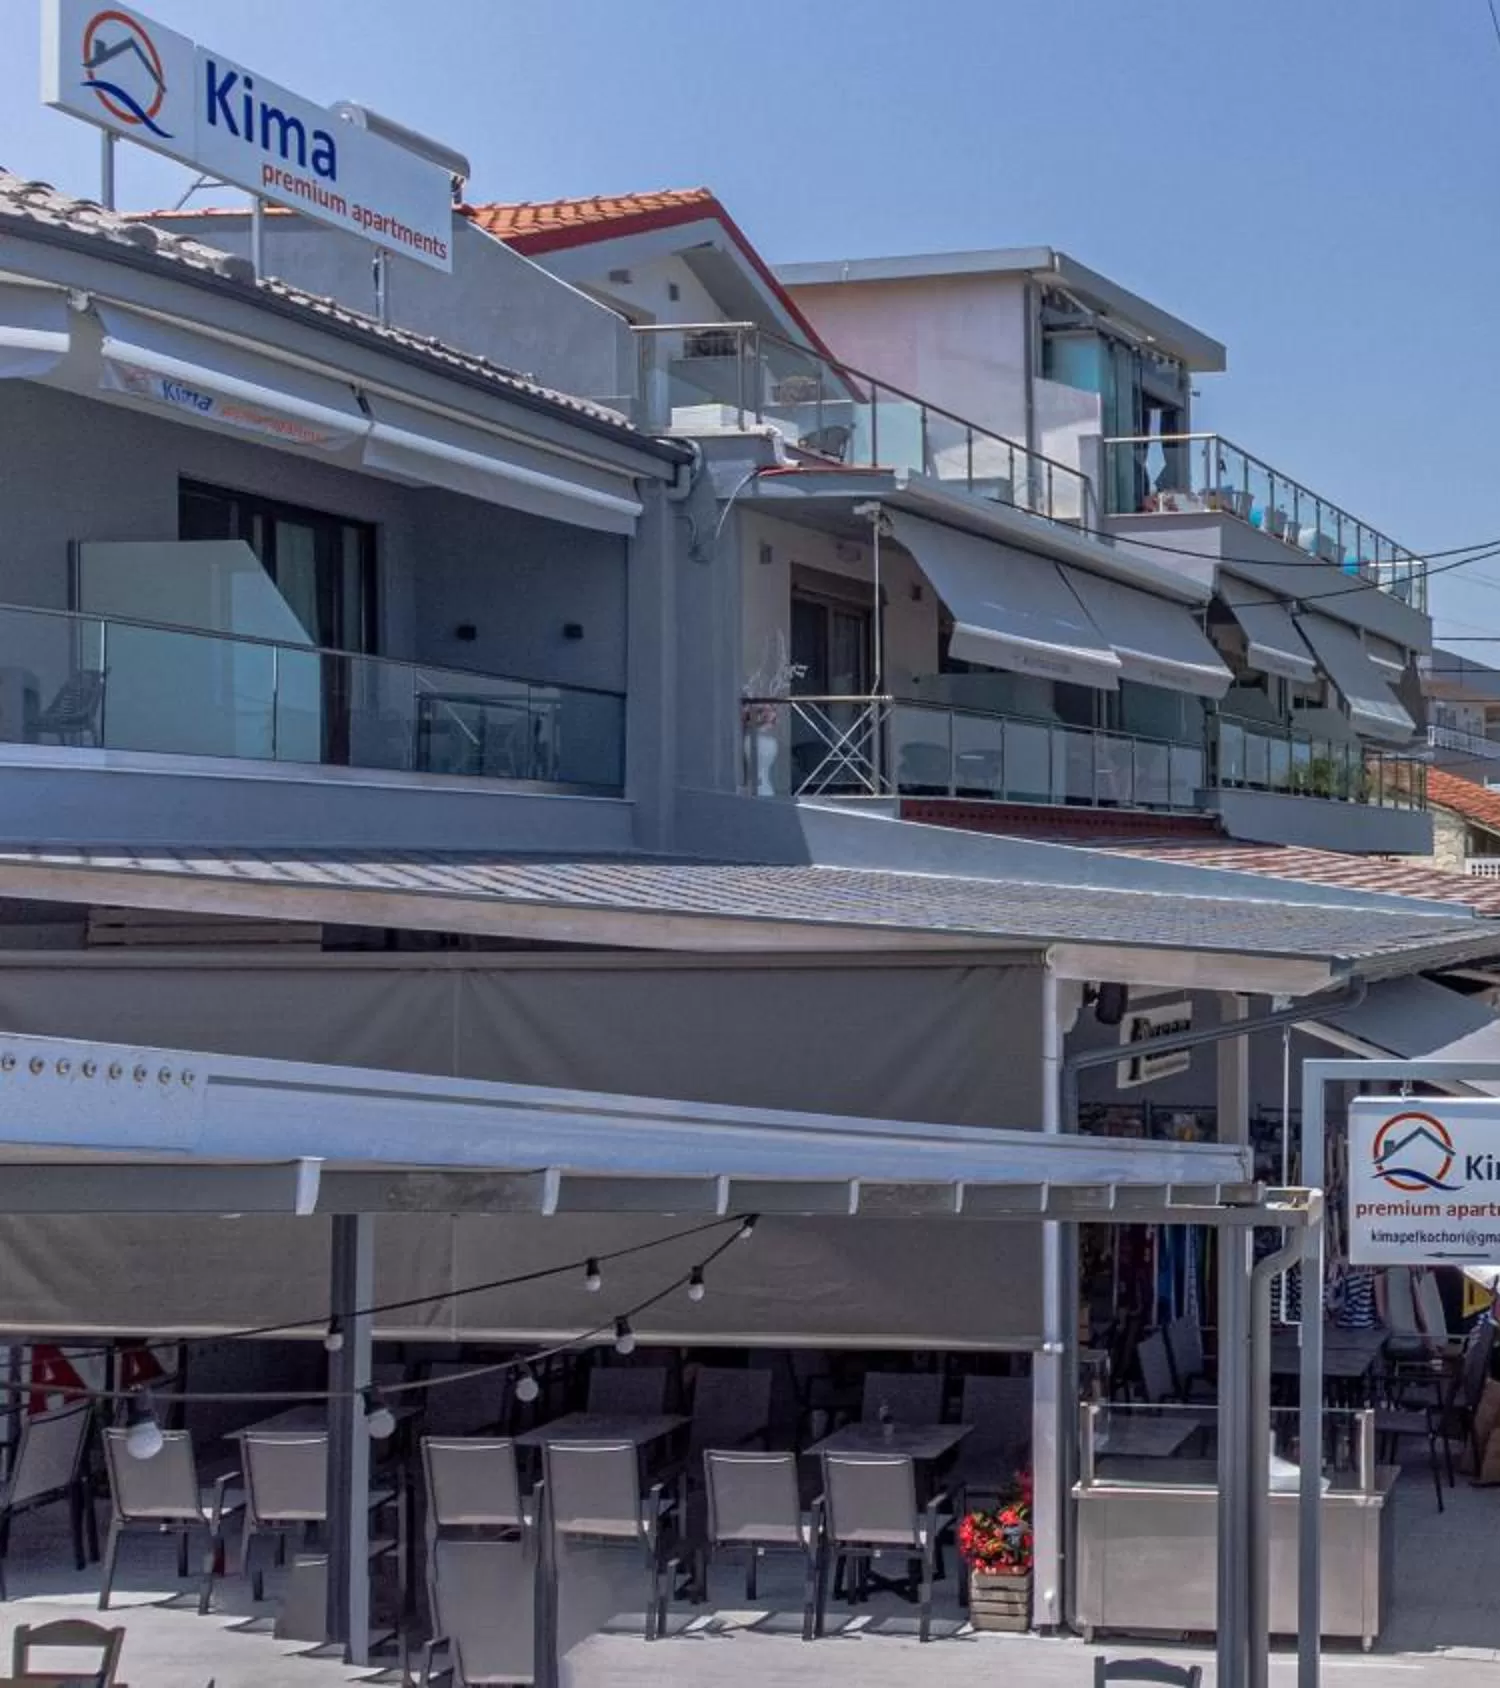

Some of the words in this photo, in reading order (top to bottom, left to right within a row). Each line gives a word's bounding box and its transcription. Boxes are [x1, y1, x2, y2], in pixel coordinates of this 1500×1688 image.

[206, 59, 337, 181] Kima
[262, 162, 347, 217] premium
[352, 203, 447, 259] apartments
[1355, 1200, 1441, 1219] premium
